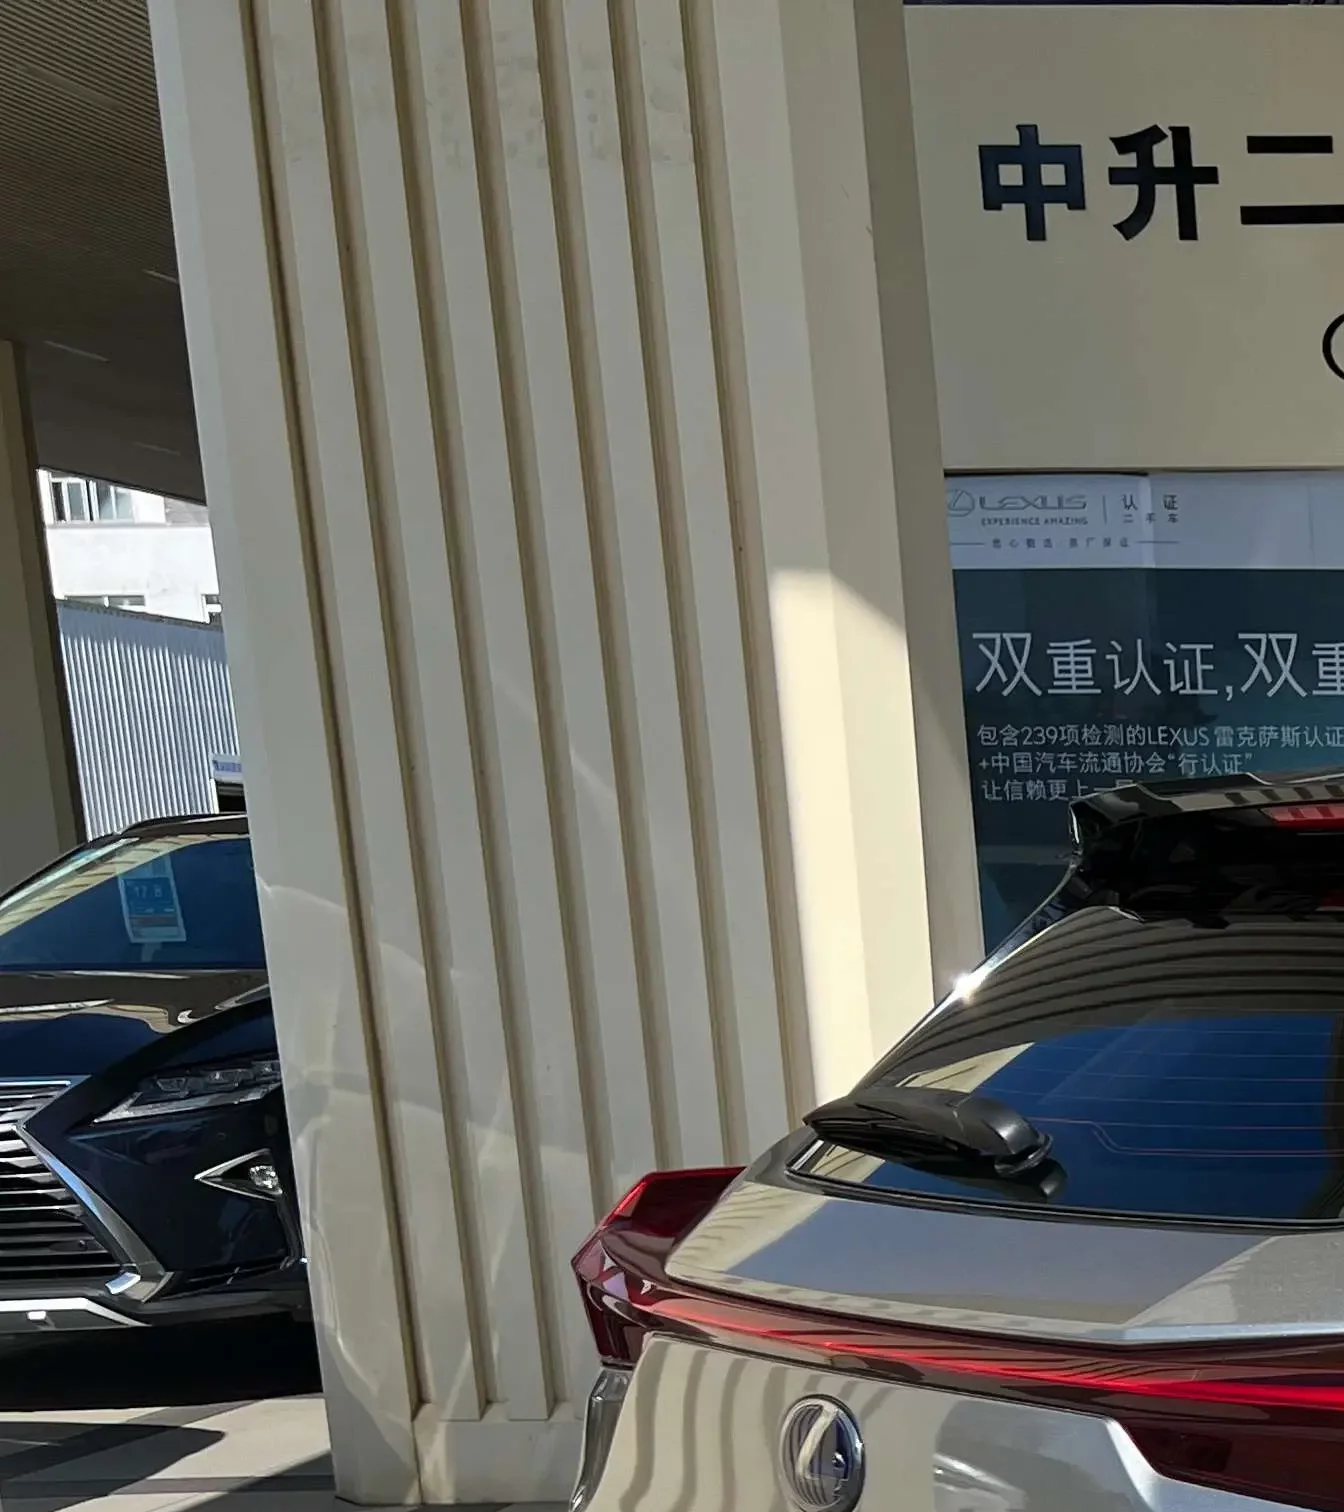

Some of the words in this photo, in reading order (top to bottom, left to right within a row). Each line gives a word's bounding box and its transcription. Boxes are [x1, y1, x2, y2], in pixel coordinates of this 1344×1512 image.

[978, 494, 1087, 511] LEXUS
[980, 516, 1041, 526] EXPERIENCE
[1043, 516, 1089, 526] AMAZING
